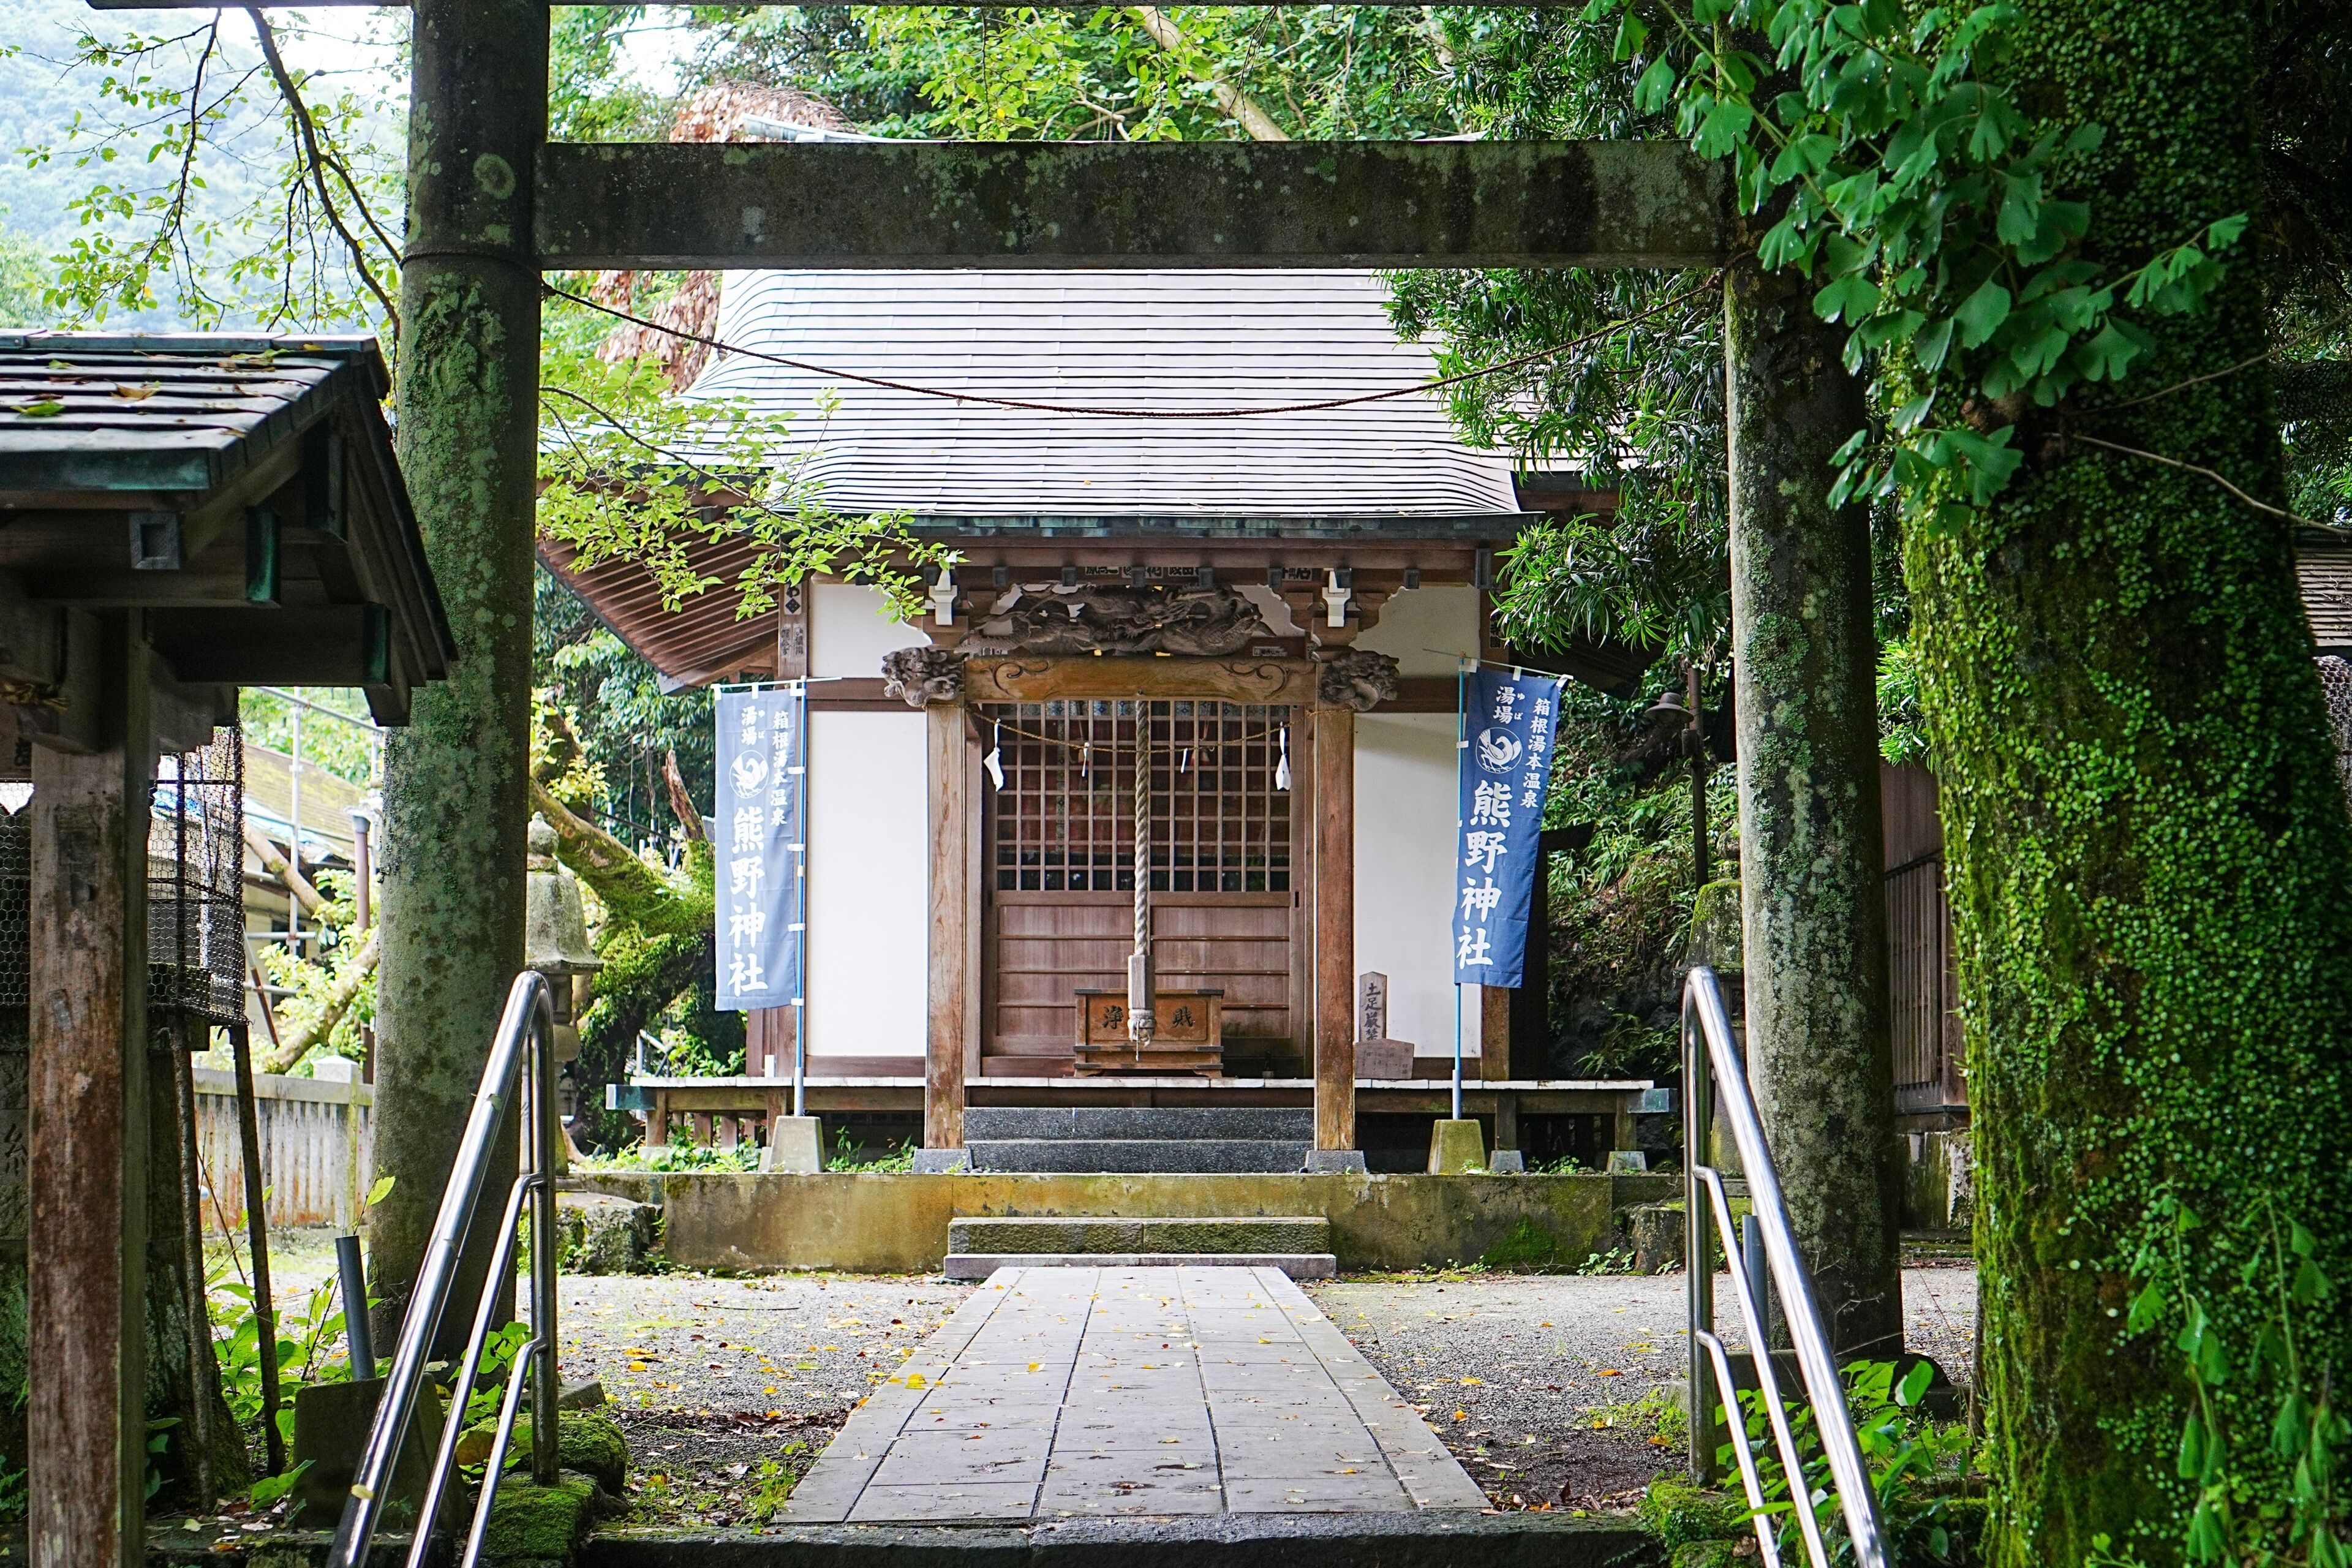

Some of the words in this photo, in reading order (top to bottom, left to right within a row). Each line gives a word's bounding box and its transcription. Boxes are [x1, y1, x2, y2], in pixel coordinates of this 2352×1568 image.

[770, 710, 789, 826] 箱根湯本温泉
[1520, 698, 1551, 809] 箱根湯本温泉
[728, 806, 769, 997] 熊野神社
[1457, 780, 1513, 970] 熊野神社
[1363, 982, 1382, 1041] 土足厳禁
